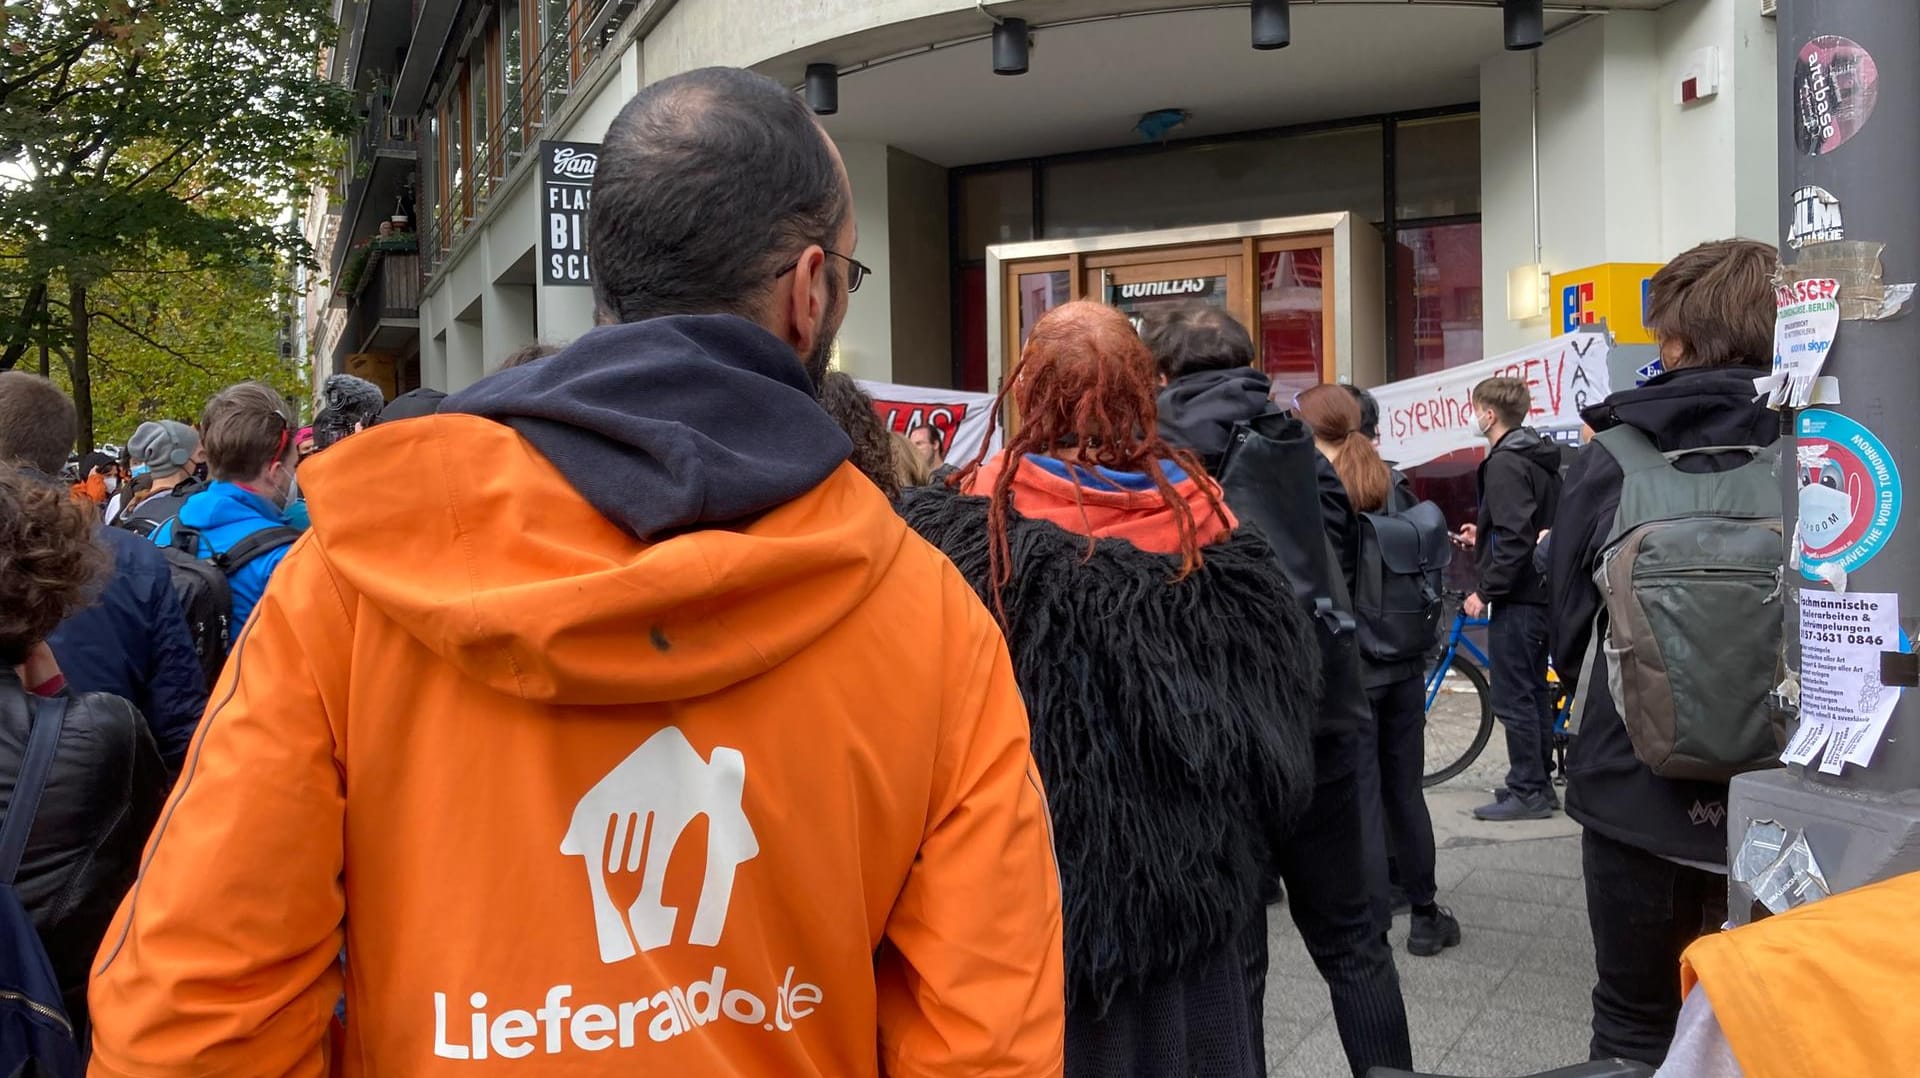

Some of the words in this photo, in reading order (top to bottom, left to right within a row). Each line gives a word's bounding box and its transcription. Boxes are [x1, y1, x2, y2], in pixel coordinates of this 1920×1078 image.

[1809, 52, 1834, 138] artbase
[1807, 340, 1831, 353] skyp
[1850, 434, 1892, 488] TOMORROW
[1876, 491, 1893, 527] WORLD
[1864, 527, 1883, 547] THE
[1840, 545, 1869, 568] RAVEL
[1862, 614, 1871, 622] &
[1848, 635, 1883, 645] 0846
[434, 966, 823, 1060] Lieferando.de
